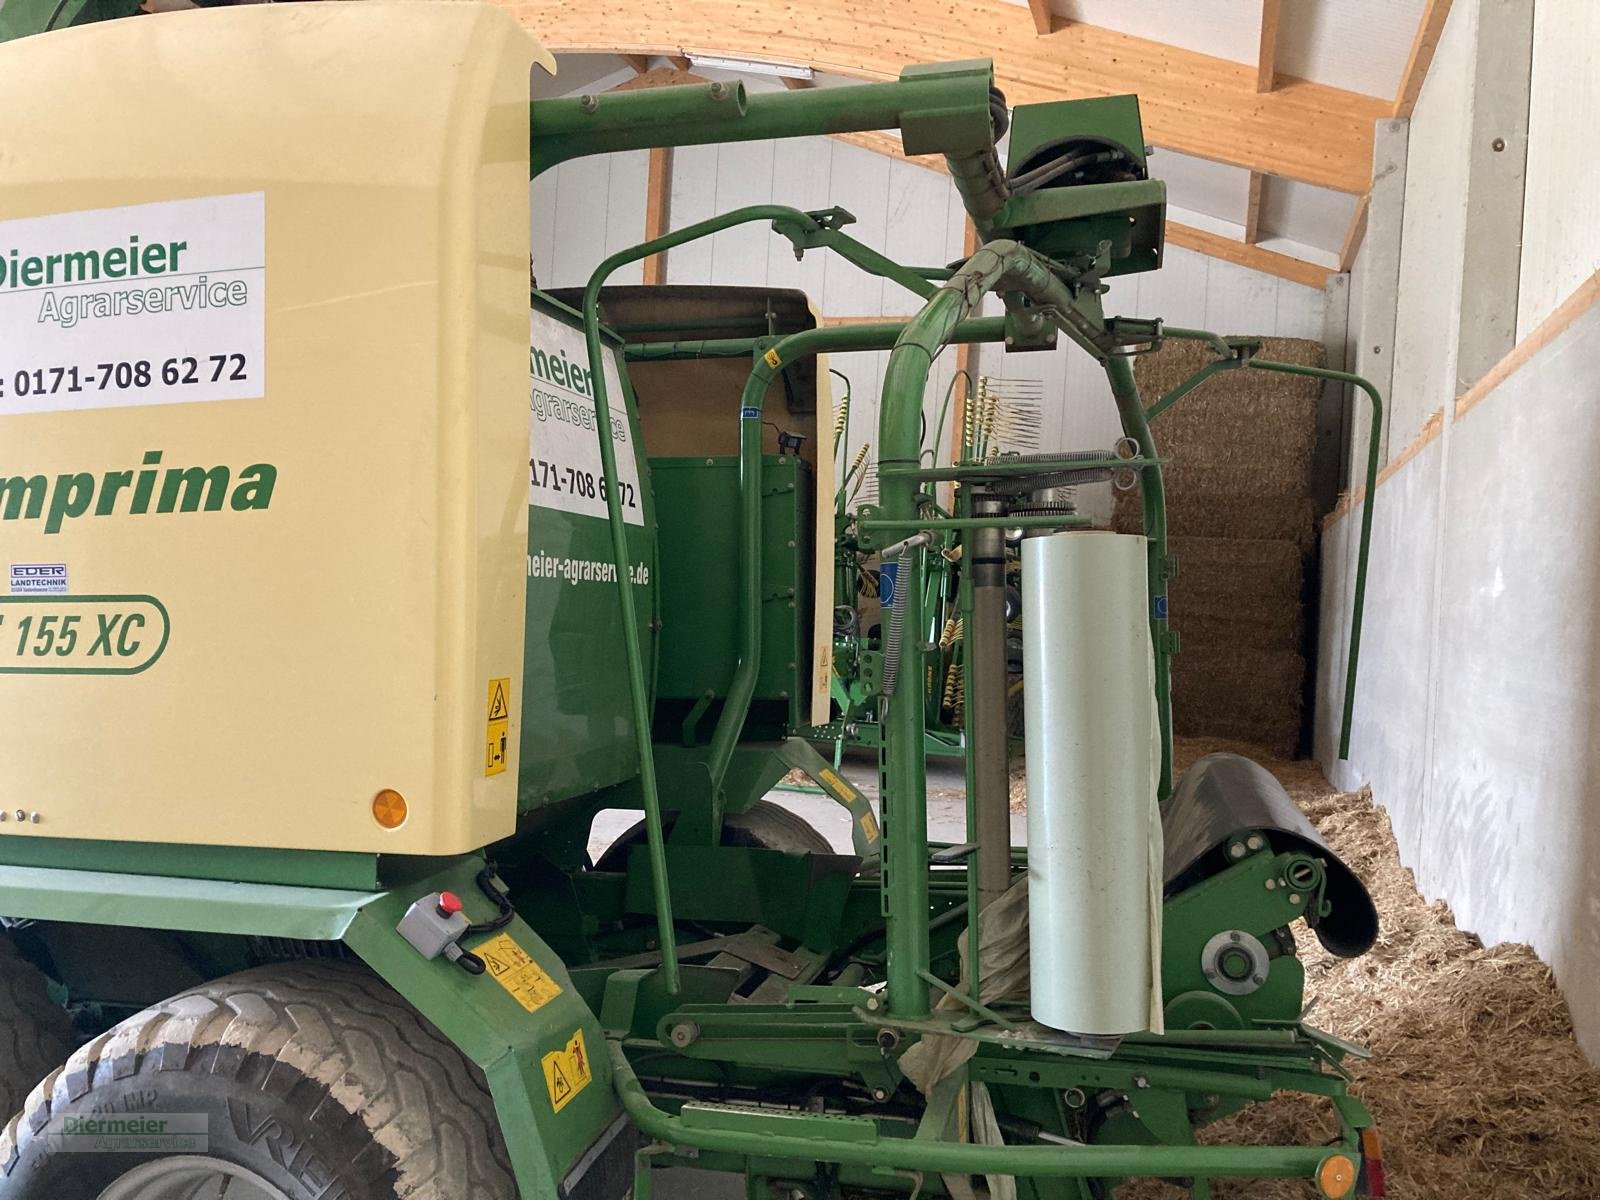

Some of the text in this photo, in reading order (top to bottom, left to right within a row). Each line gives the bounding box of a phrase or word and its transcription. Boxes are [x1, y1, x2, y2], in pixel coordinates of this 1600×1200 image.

[0, 235, 187, 290] iermeier
[38, 275, 248, 328] Agrarservice
[14, 360, 151, 397] 0171-708
[161, 357, 199, 386] 62
[209, 353, 247, 382] 72
[13, 566, 65, 576] EDER
[16, 613, 146, 657] 155 XC
